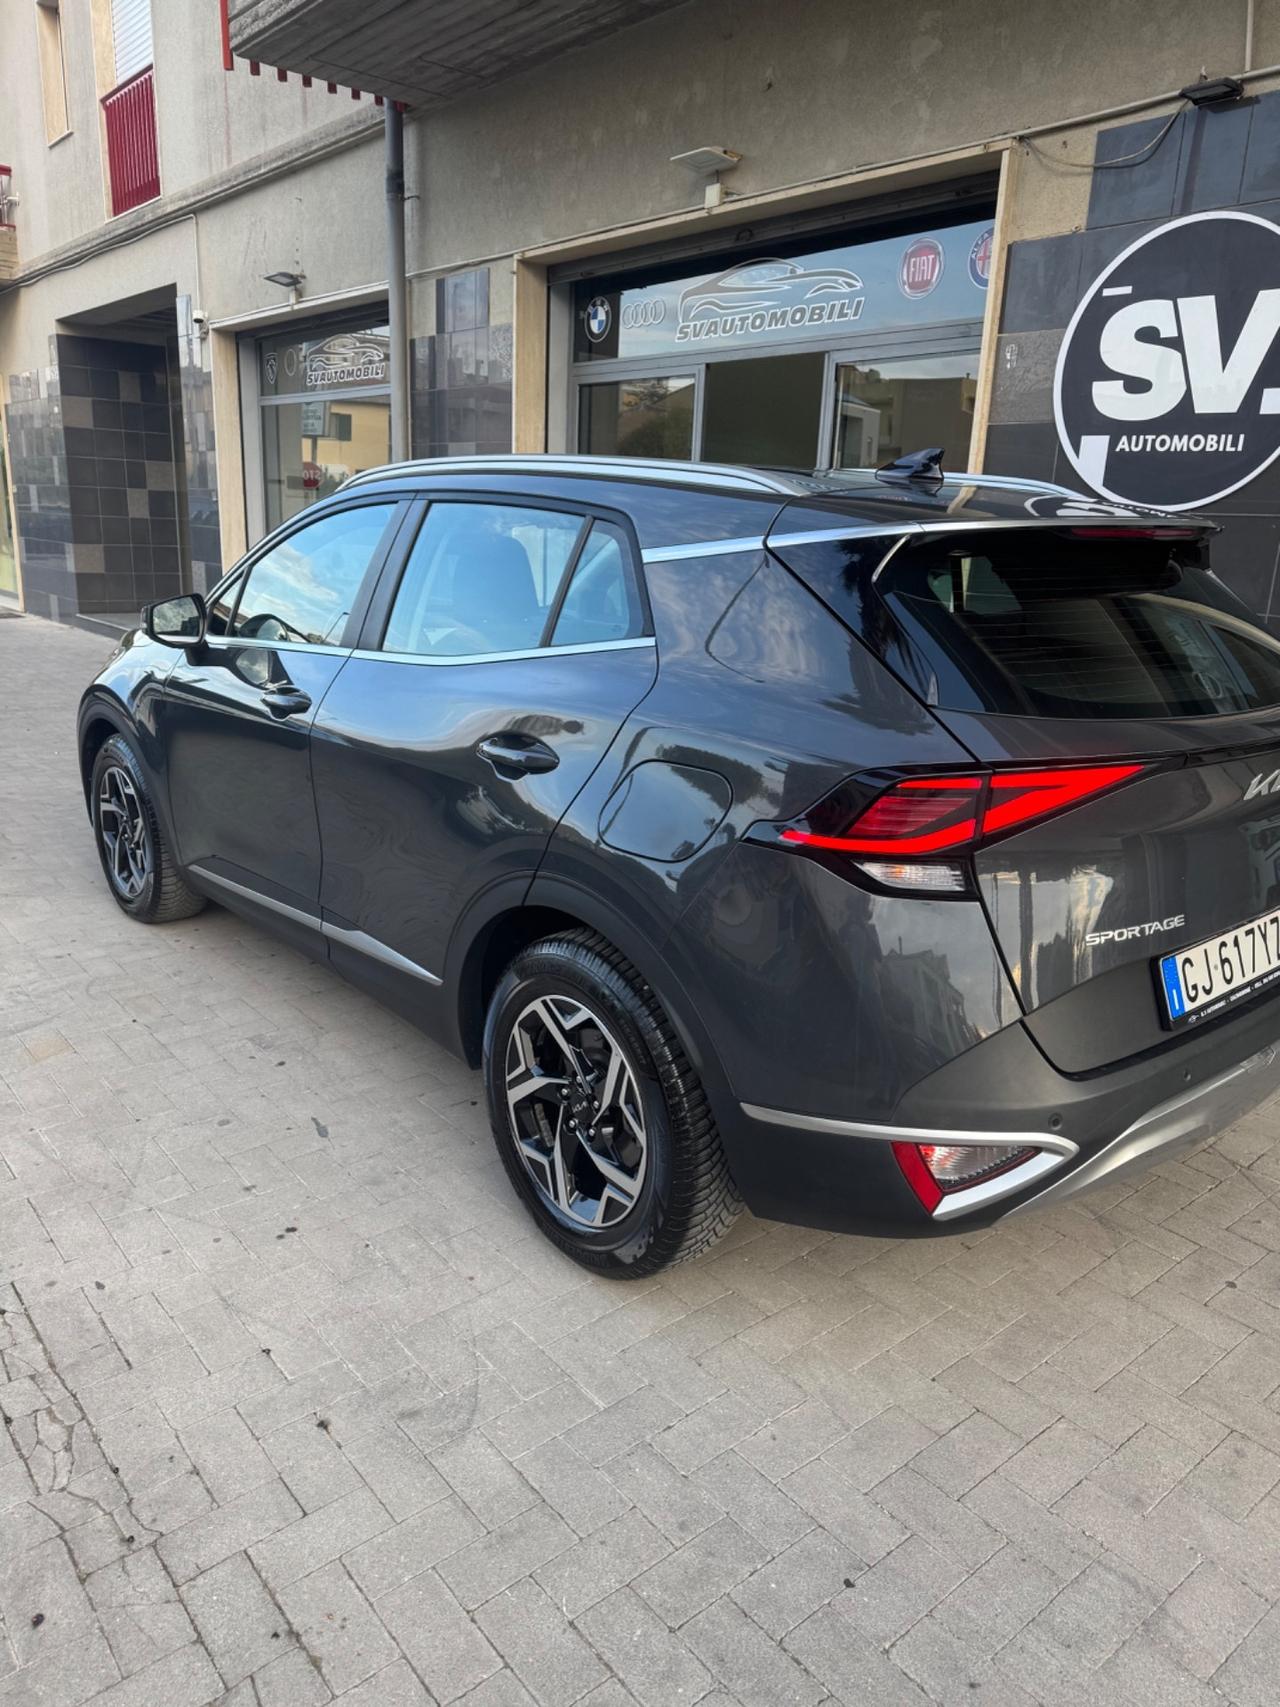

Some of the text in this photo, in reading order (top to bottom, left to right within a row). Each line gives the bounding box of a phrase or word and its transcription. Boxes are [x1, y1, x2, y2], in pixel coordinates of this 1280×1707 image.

[908, 254, 935, 283] FIAT
[675, 297, 865, 342] SVAUTOMOBILI
[306, 363, 385, 385] SVAUTOMOBILI
[1116, 433, 1245, 452] AUTOMOBILI
[1086, 915, 1185, 946] SPORTAGE
[1173, 989, 1180, 1010] I
